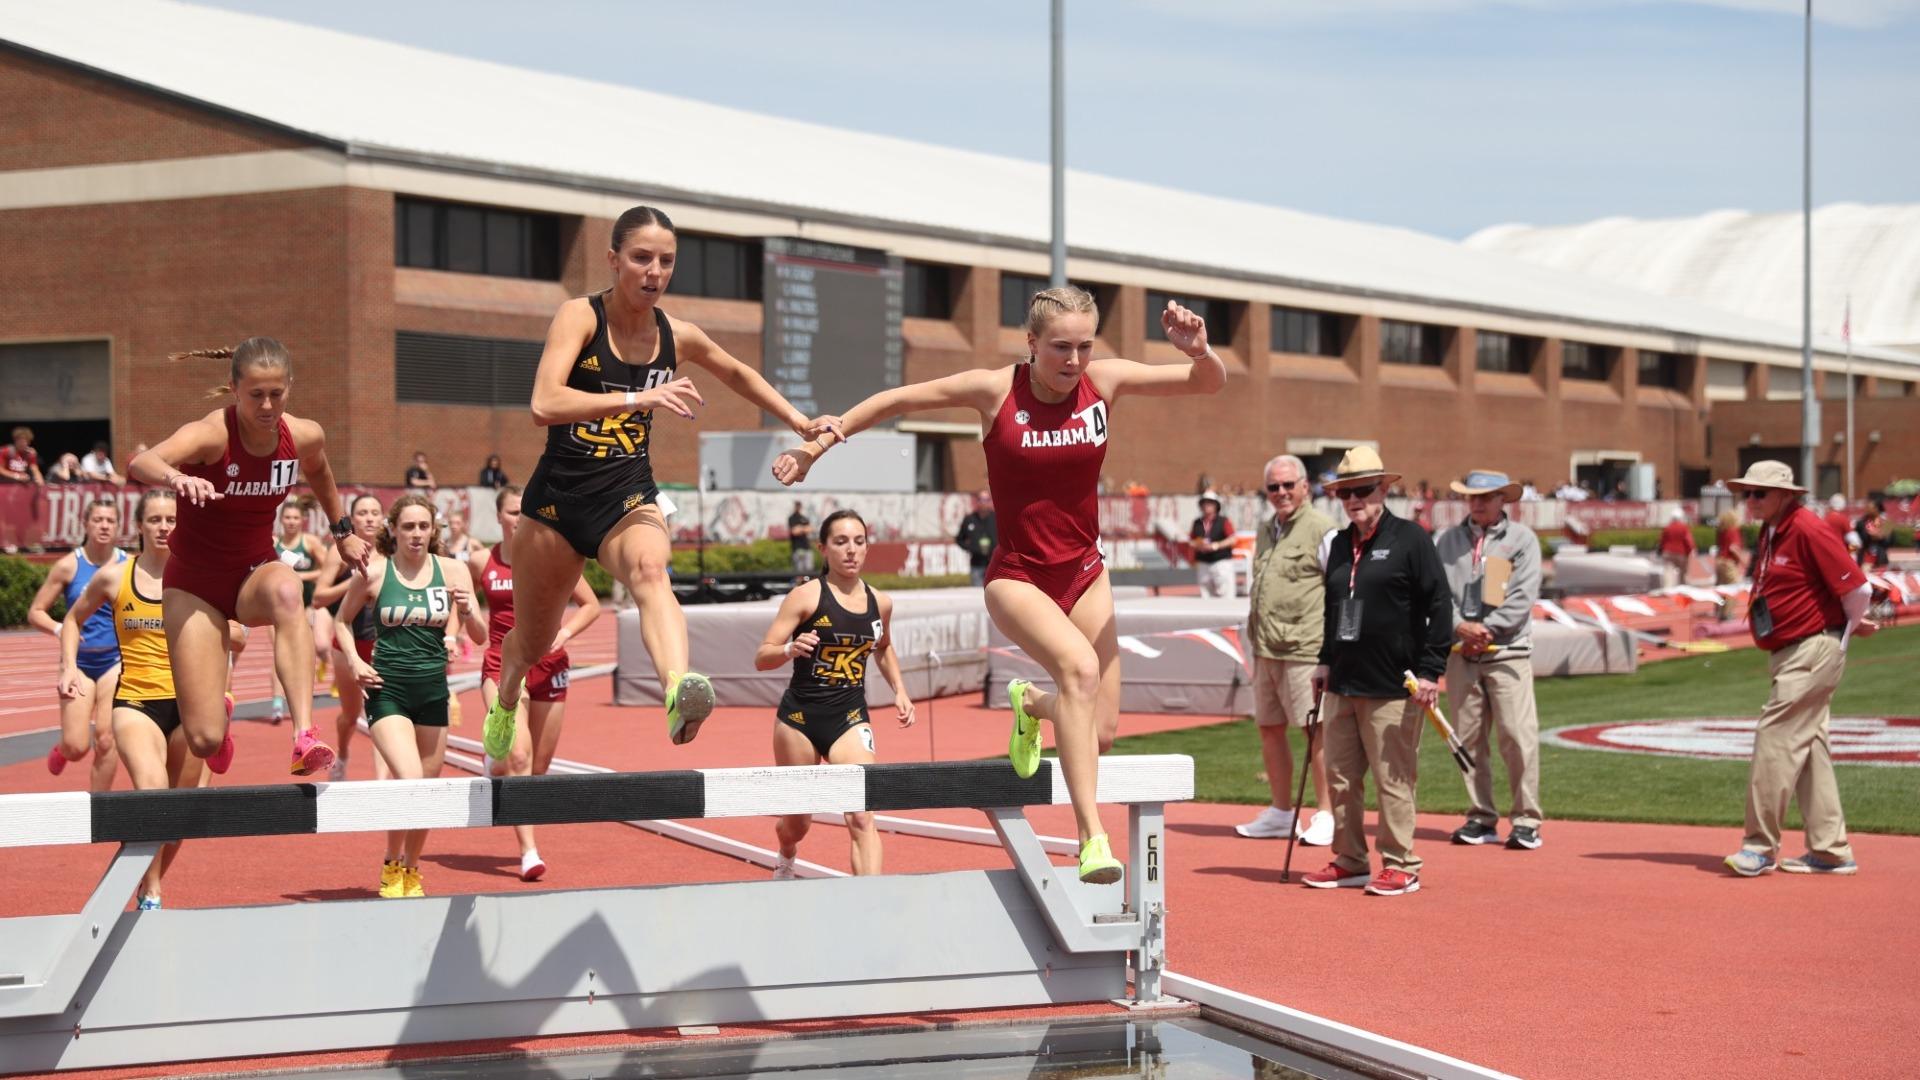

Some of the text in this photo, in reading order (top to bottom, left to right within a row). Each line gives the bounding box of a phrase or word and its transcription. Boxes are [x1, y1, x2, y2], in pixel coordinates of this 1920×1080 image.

[1093, 405, 1105, 438] 4
[274, 461, 294, 485] 11
[433, 589, 444, 611] 5
[124, 618, 164, 630] SOUTHER
[381, 606, 449, 627] UAB
[1148, 835, 1157, 881] UCS
